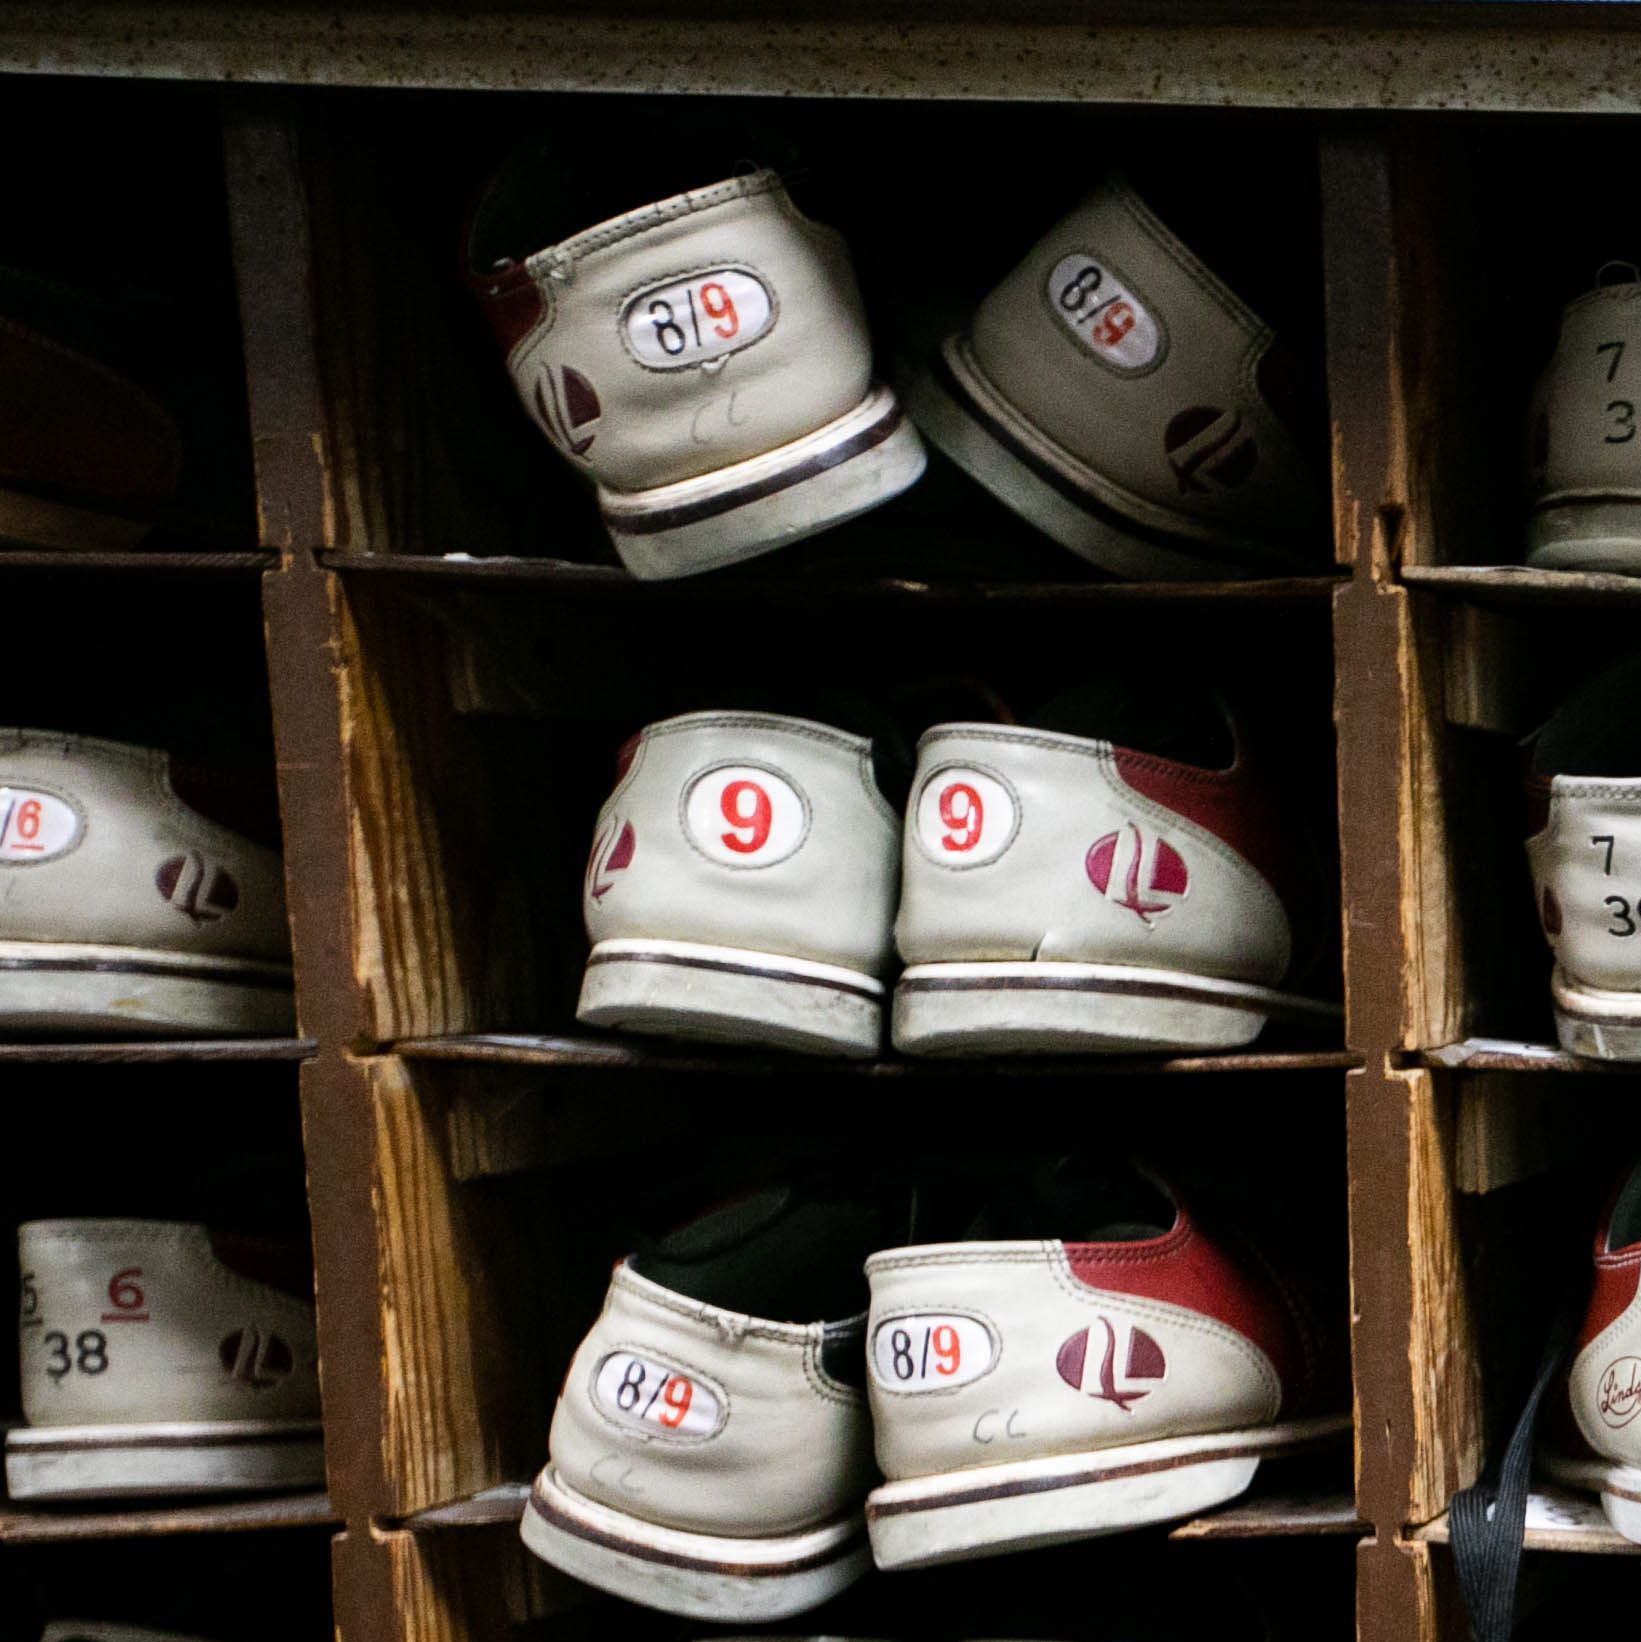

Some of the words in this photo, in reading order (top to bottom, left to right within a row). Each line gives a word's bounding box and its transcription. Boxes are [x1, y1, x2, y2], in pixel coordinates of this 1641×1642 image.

[648, 281, 740, 357] 8/9
[1596, 341, 1627, 384] 7
[720, 780, 772, 855] 9
[939, 782, 983, 852] 9
[1590, 836, 1617, 875] 7
[109, 1267, 144, 1309] 6
[45, 1331, 108, 1377] 38
[892, 1325, 962, 1380] 8/9
[617, 1360, 693, 1428] 8/9
